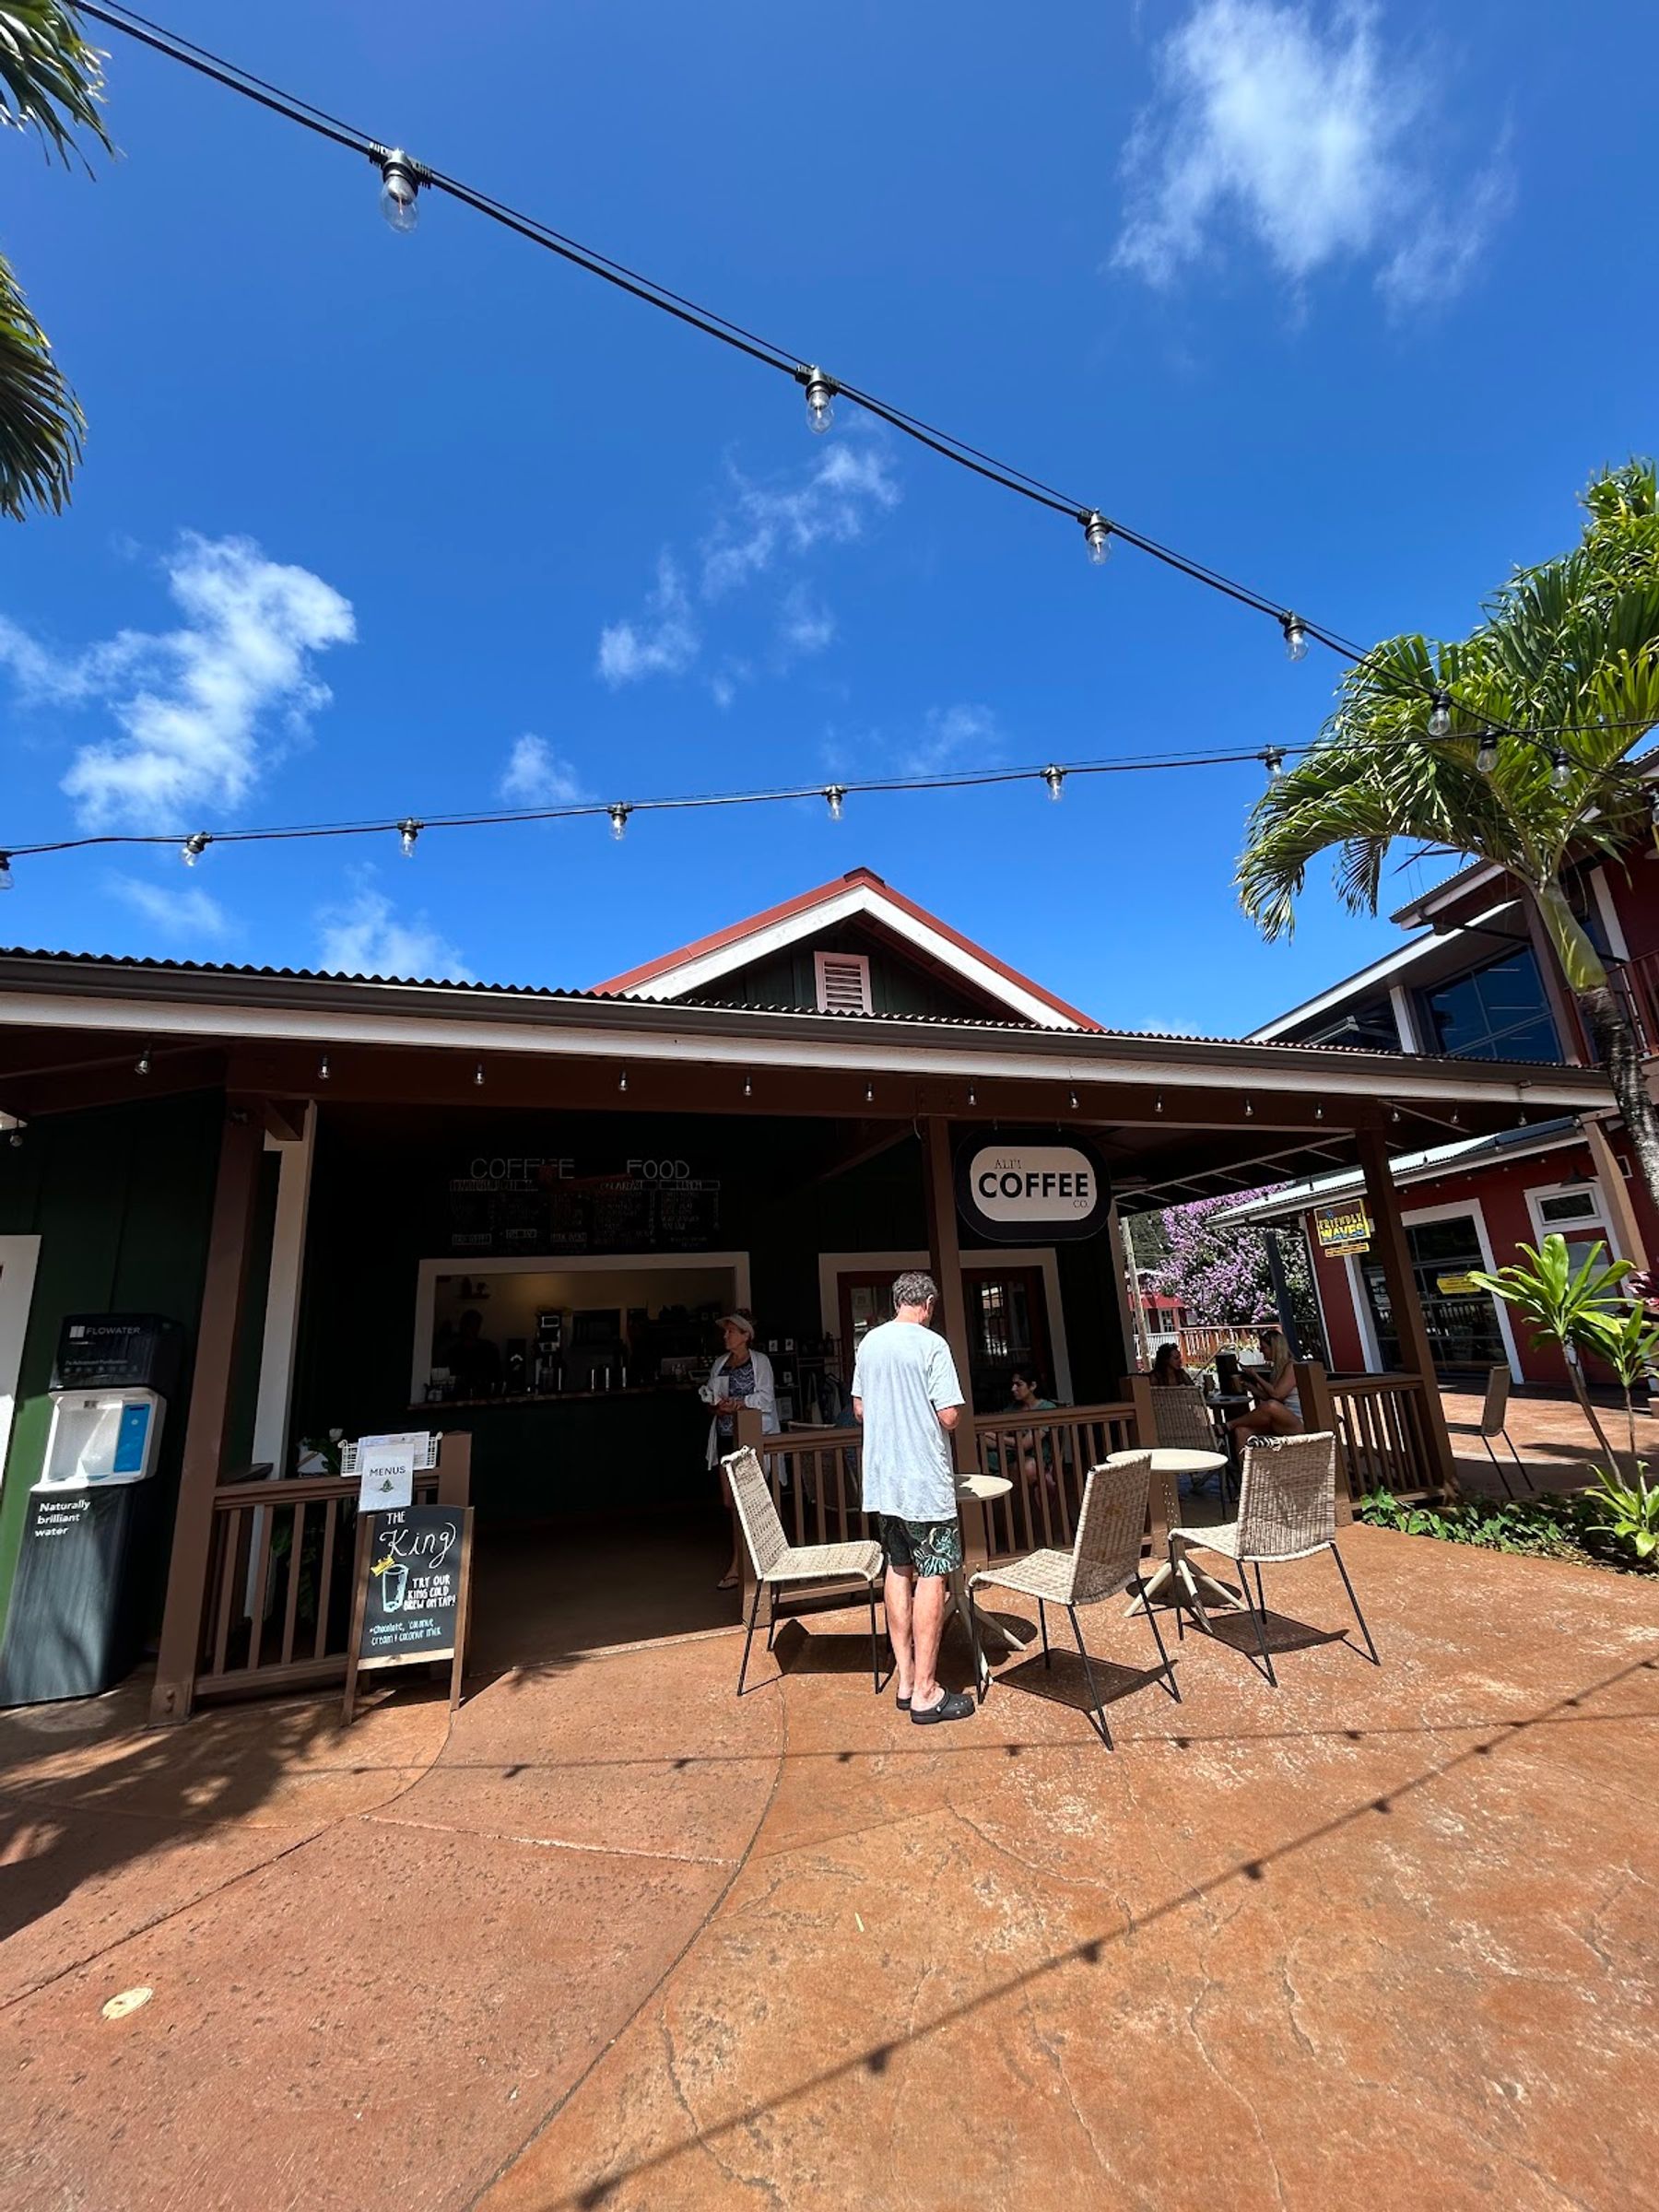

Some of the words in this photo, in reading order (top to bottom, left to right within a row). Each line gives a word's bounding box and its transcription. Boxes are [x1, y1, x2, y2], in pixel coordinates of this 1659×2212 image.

[626, 1159, 690, 1180] FOOD
[978, 1171, 1088, 1198] COFFEE
[1319, 1213, 1362, 1230] FRIENDLY
[1320, 1223, 1365, 1238] WAVES
[86, 1326, 141, 1335] FLOWATER
[369, 1465, 406, 1477] MENUS
[39, 1499, 90, 1512] Naturally
[37, 1513, 80, 1525] brilliant
[385, 1511, 406, 1525] THE
[34, 1527, 69, 1537] water
[379, 1522, 456, 1569] King
[412, 1576, 429, 1588] TRY
[433, 1574, 451, 1586] OUR
[407, 1588, 428, 1600] KING
[429, 1585, 449, 1597] COLD
[403, 1599, 425, 1611] BREW
[426, 1597, 437, 1608] ON
[438, 1594, 456, 1607] TAP!
